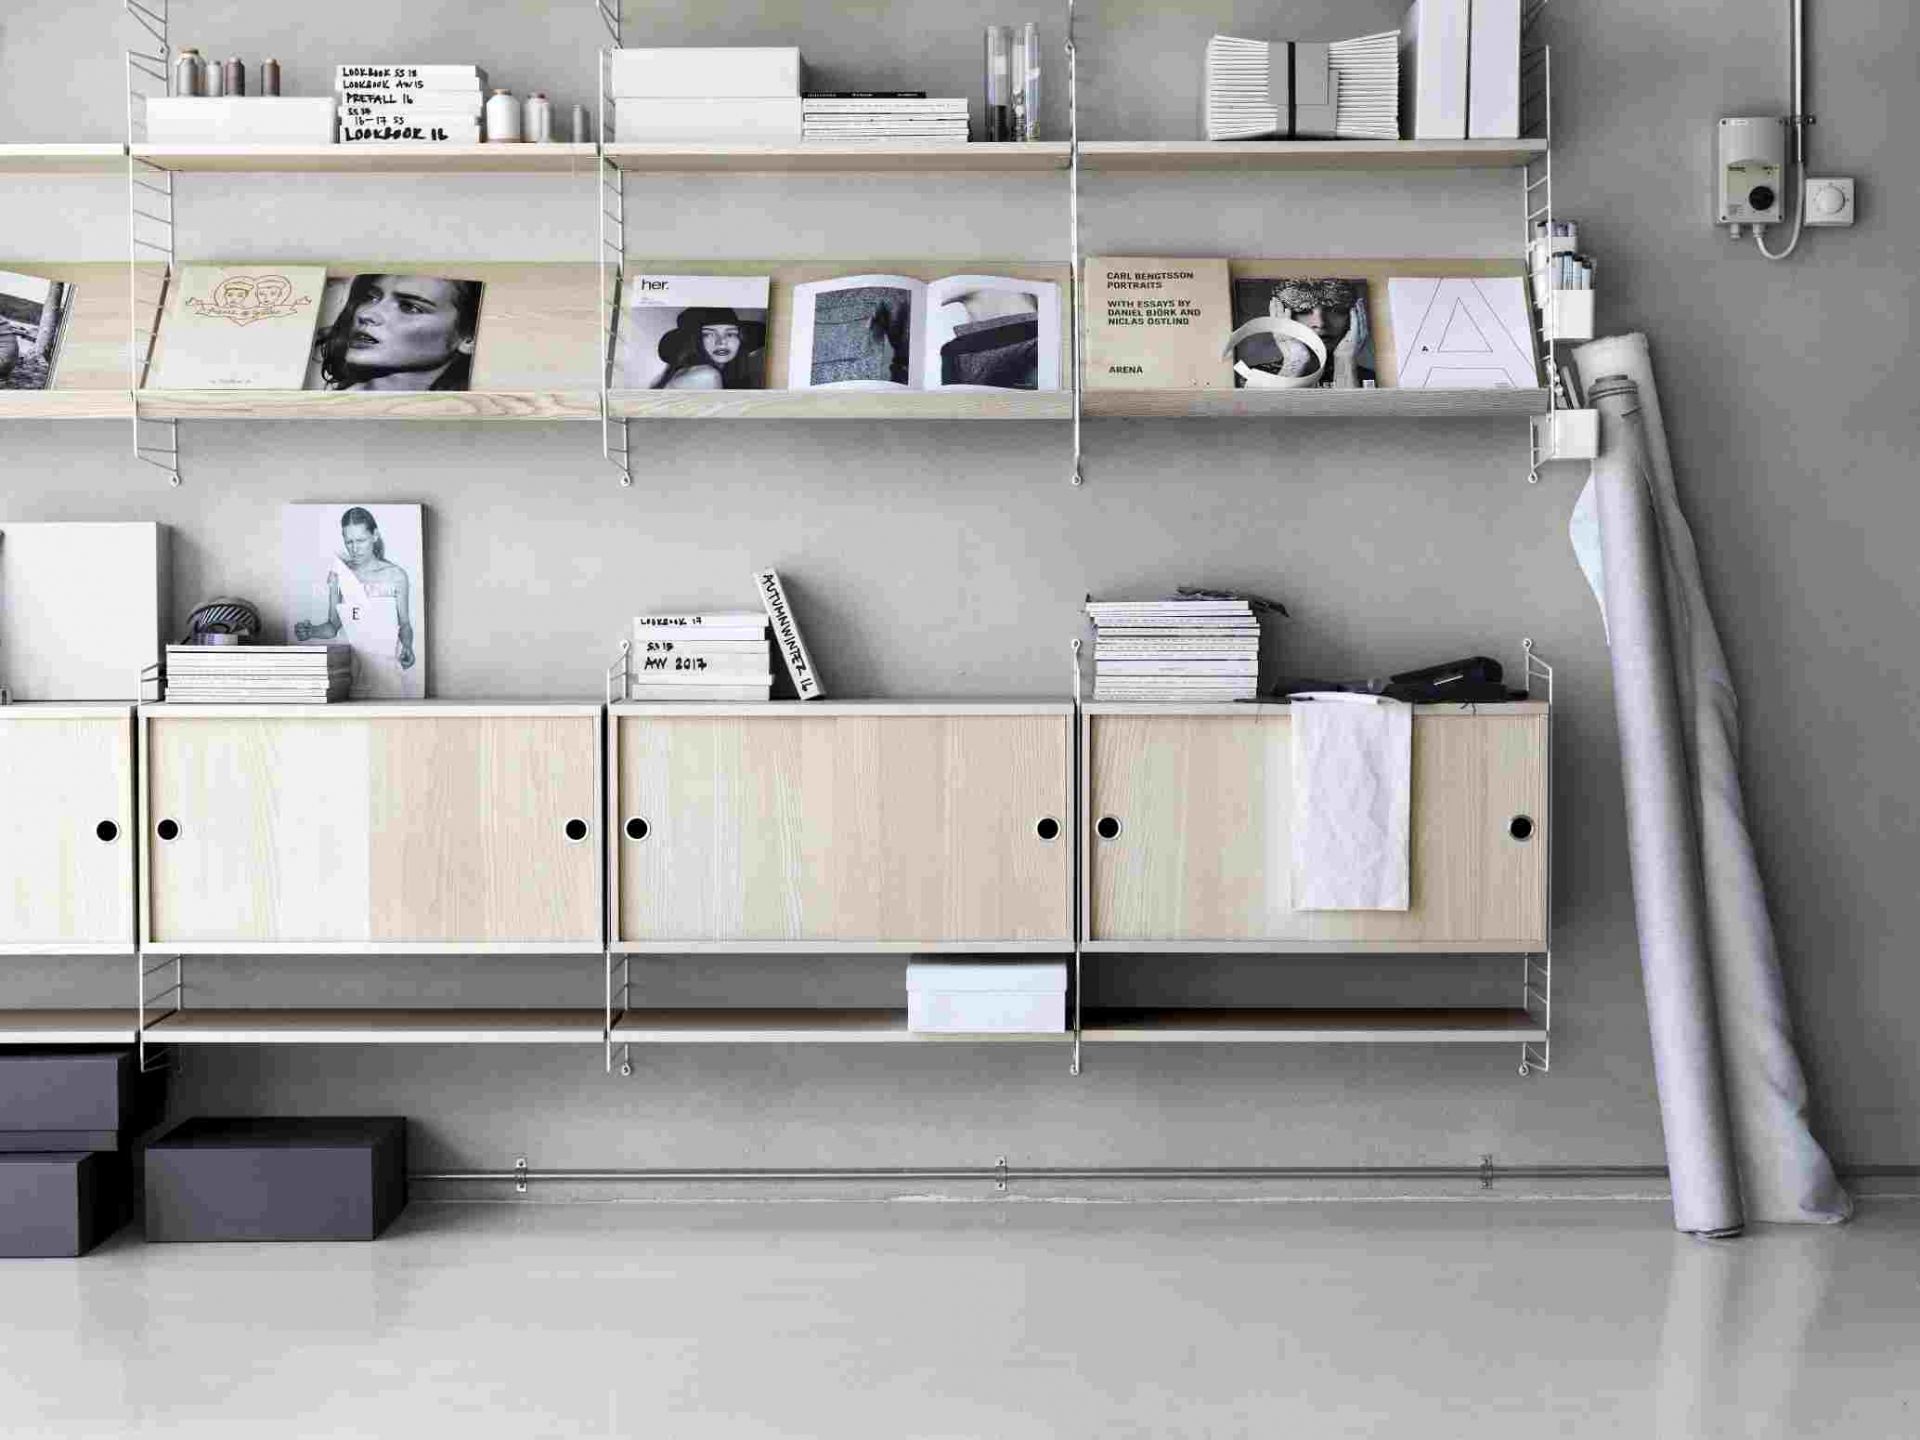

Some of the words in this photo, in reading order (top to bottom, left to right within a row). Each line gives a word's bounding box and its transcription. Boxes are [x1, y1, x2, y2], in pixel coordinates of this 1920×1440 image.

[346, 92, 397, 104] PREFALL
[344, 127, 427, 141] LOOKBOOK
[1106, 272, 1132, 280] CARL
[1135, 272, 1194, 280] BENGTSSON
[1107, 300, 1134, 308] WITH
[1137, 300, 1175, 308] ESSAYS
[1107, 309, 1143, 317] DANIEL
[1181, 308, 1201, 316] AND
[1108, 317, 1144, 326] NICLAS
[1108, 366, 1143, 374] ARENA
[644, 656, 667, 670] AW
[675, 657, 707, 671] 2017
